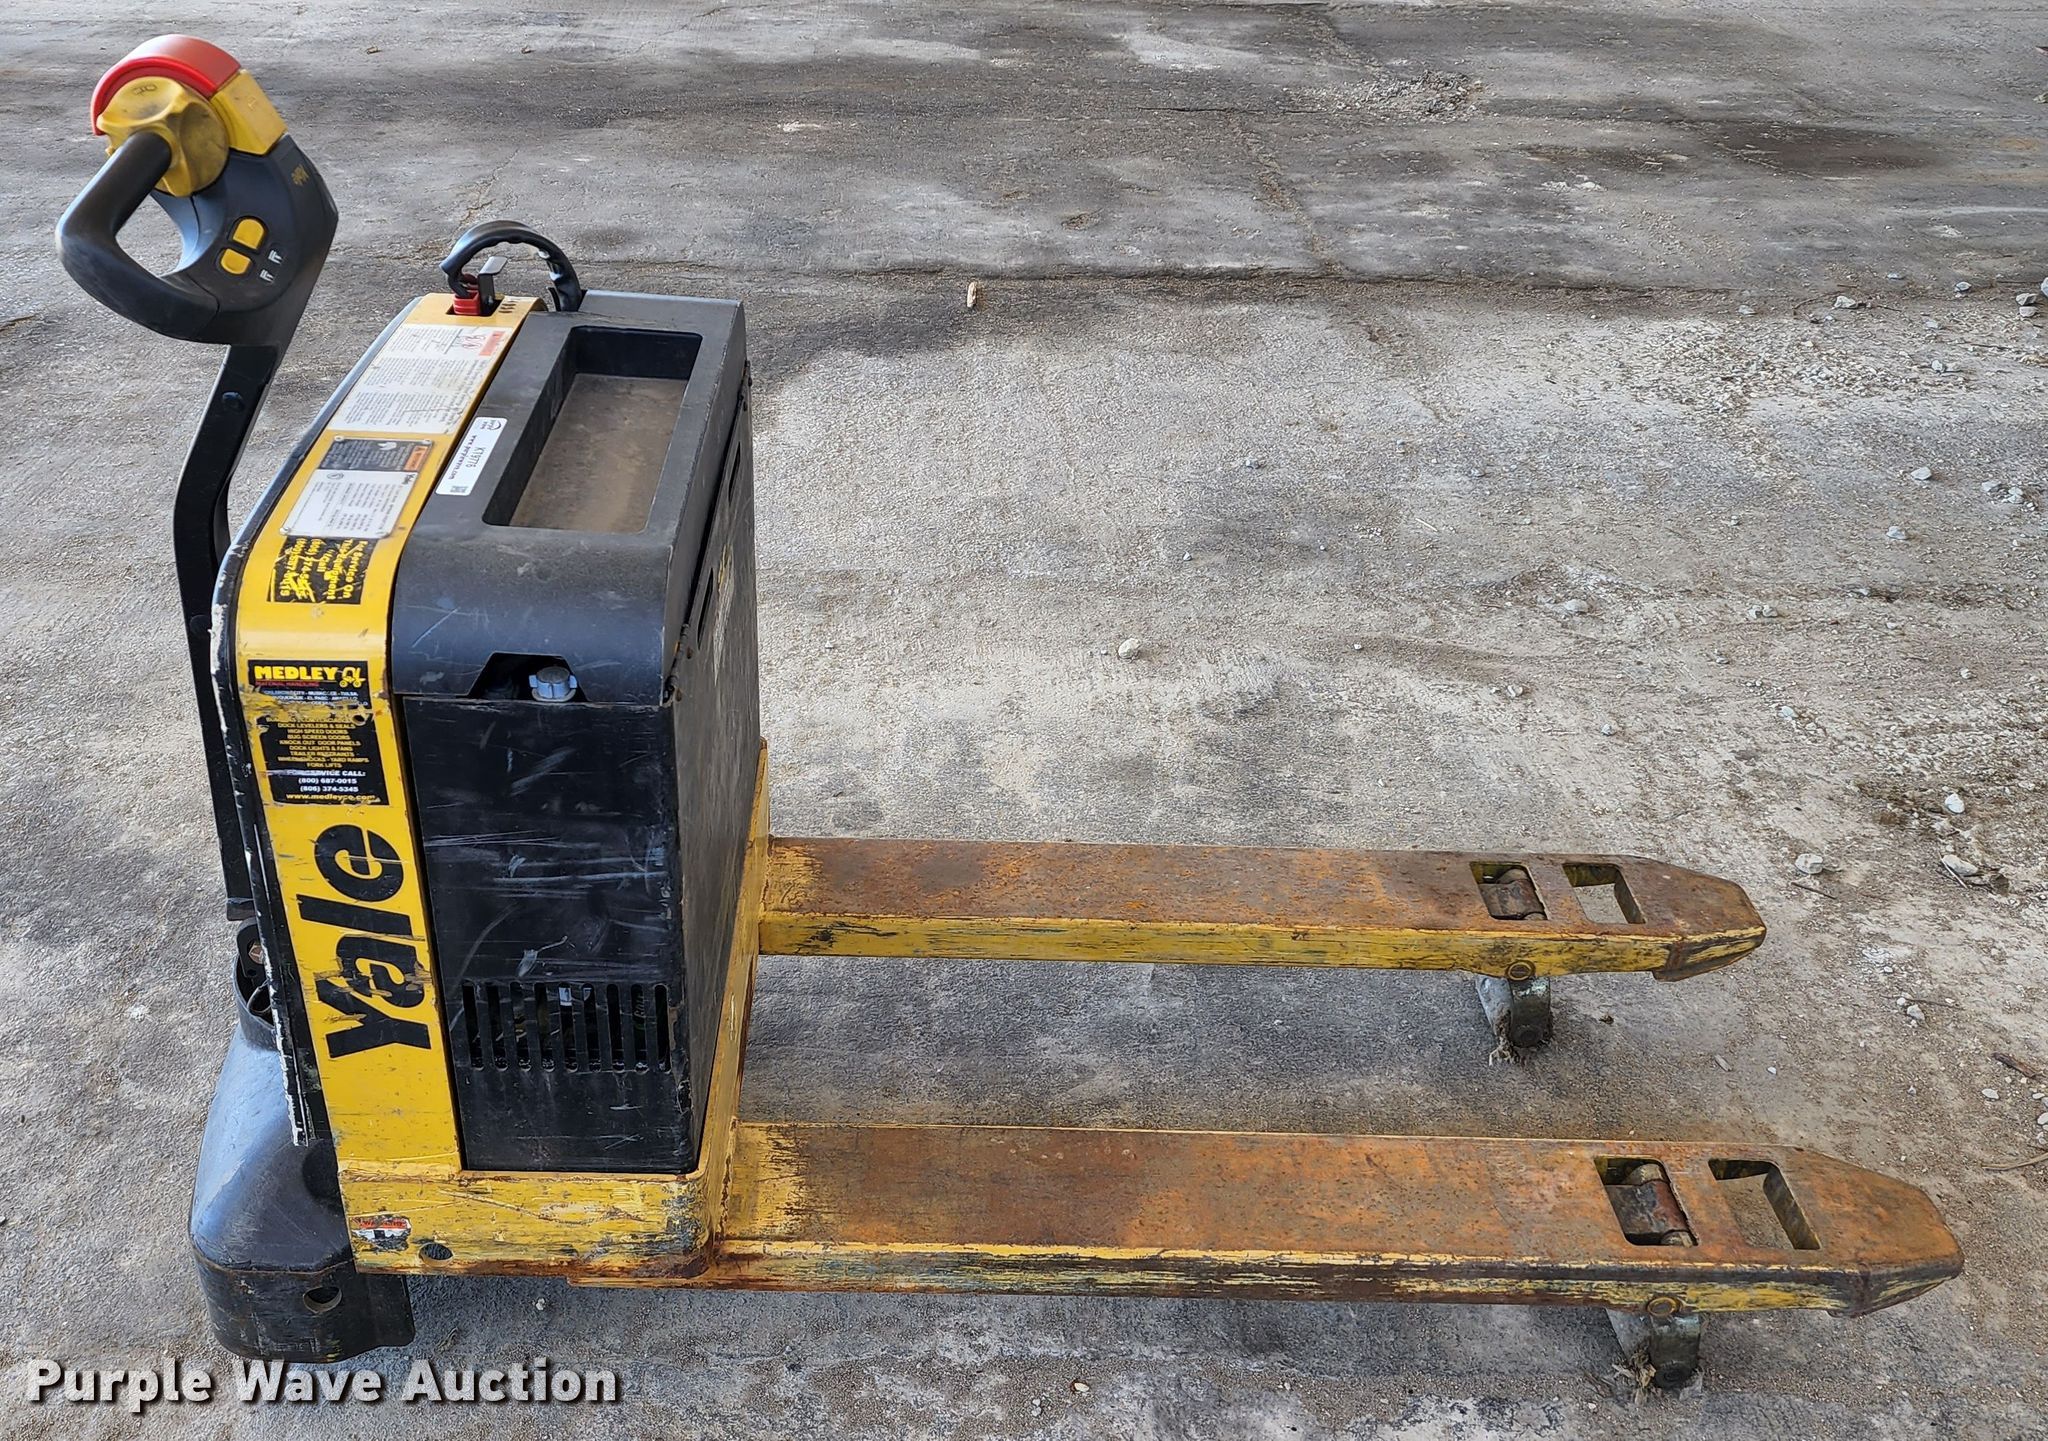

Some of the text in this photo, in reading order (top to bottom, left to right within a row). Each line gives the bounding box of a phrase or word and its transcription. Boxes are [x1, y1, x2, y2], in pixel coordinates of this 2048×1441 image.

[345, 552, 363, 583] Service
[342, 584, 354, 598] On
[254, 666, 337, 680] MEDLEY
[296, 824, 431, 1058] Yale
